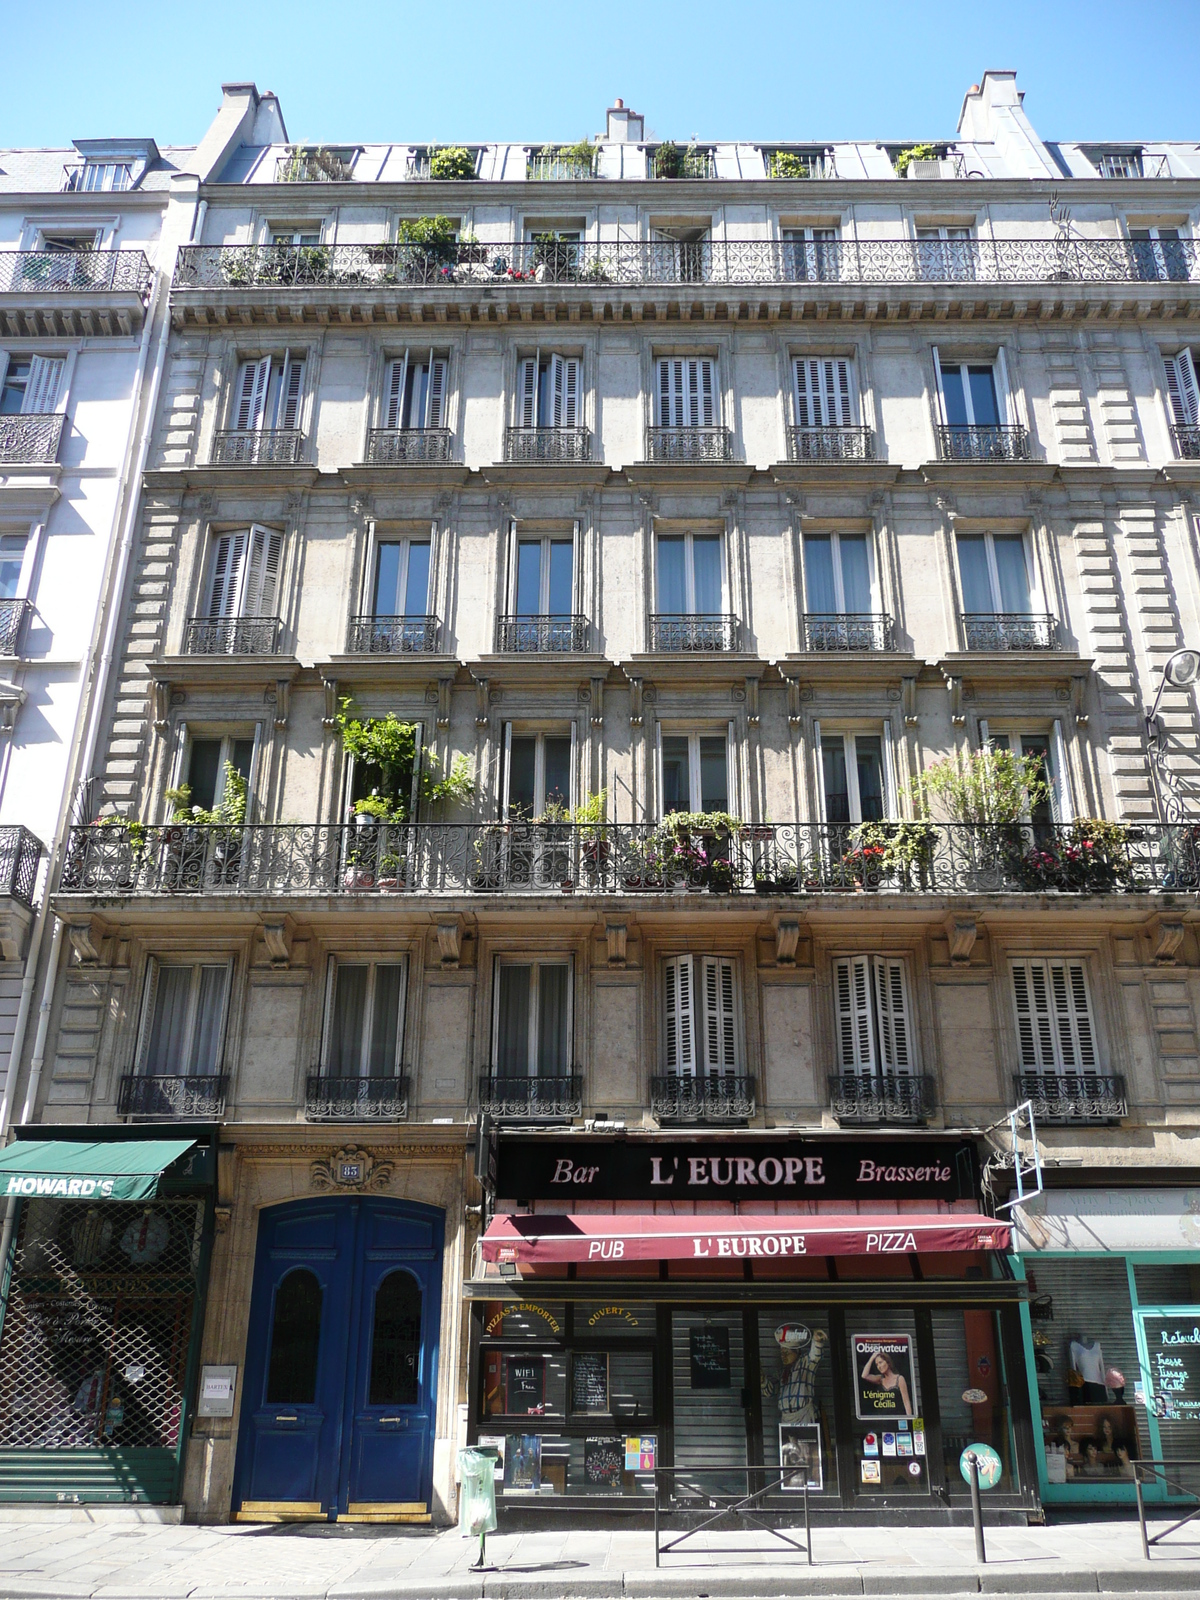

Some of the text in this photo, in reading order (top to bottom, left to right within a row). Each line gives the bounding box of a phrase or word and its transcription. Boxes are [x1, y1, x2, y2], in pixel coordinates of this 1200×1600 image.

[344, 1166, 357, 1176] 83
[551, 1157, 951, 1185] Bar L'EUROPE Brasserie
[7, 1177, 114, 1196] HOWARD'S
[1105, 1192, 1164, 1207] Espace
[588, 1232, 917, 1259] PUB L'EUROPE PIZZA
[486, 1303, 560, 1333] PIZZAS A EMPORTER
[588, 1306, 639, 1326] OUVERT 7/7
[856, 1342, 908, 1353] Observateur
[1156, 1352, 1184, 1367] Tresse
[1157, 1366, 1190, 1383] Tissage
[863, 1390, 895, 1399] L'énigme
[874, 1399, 896, 1408] Cécilia
